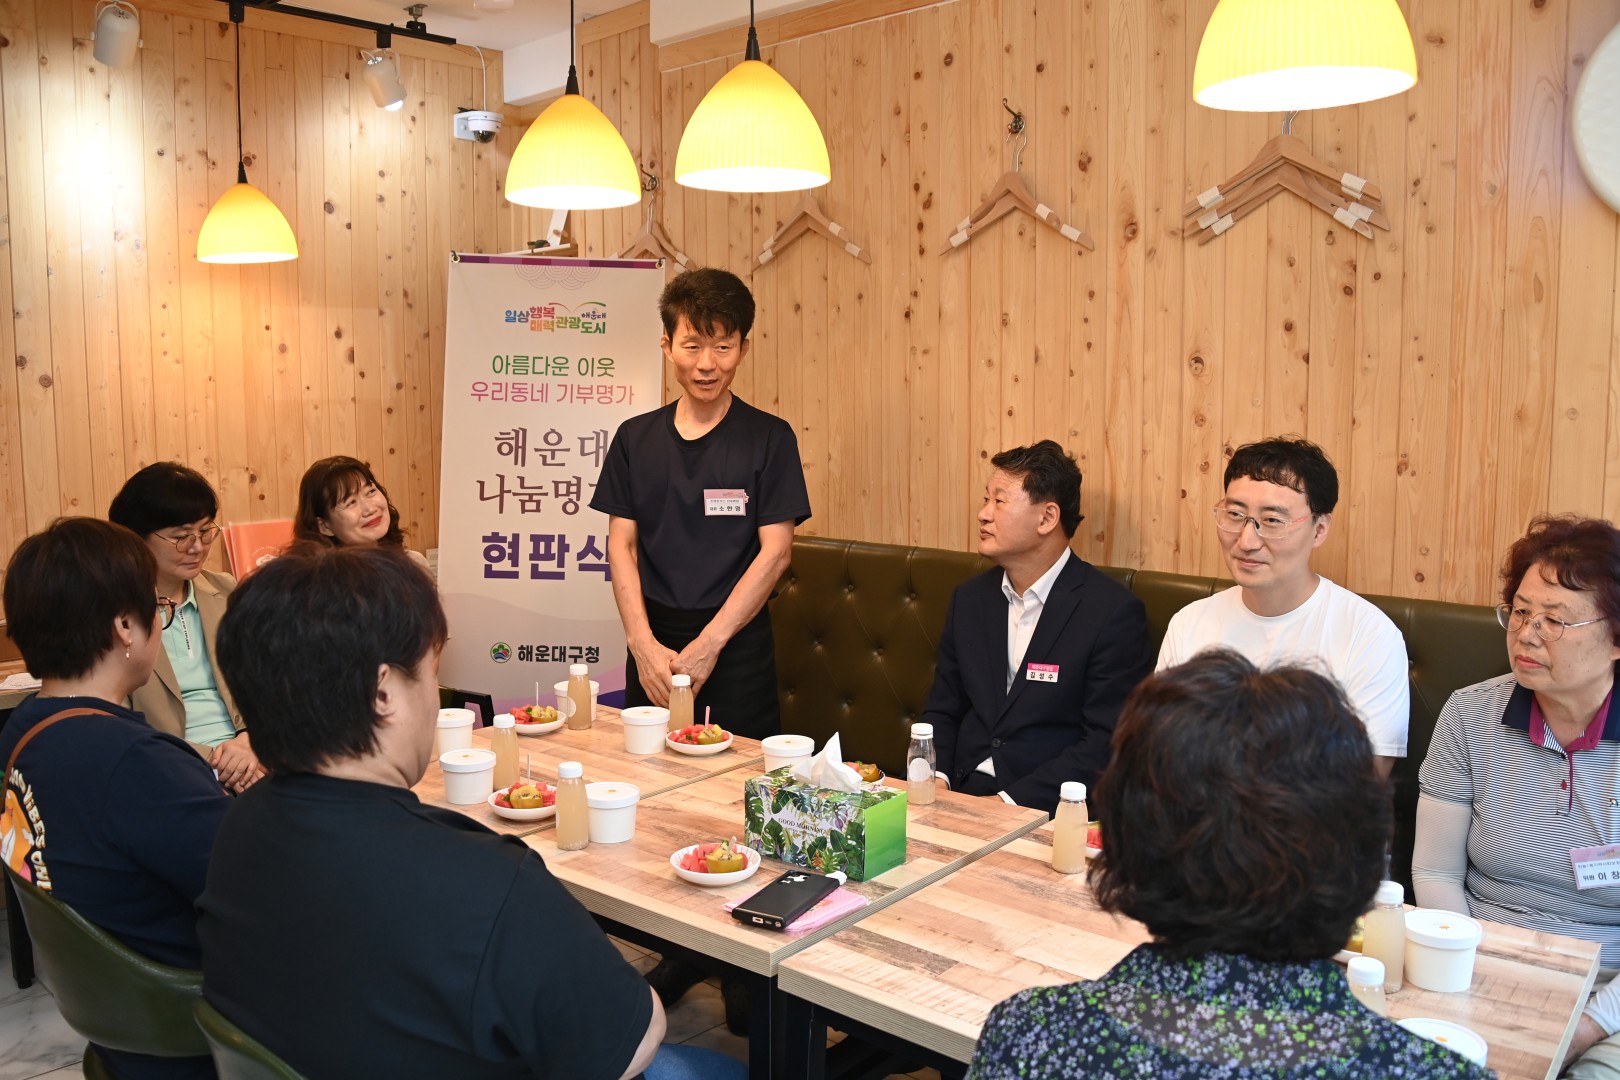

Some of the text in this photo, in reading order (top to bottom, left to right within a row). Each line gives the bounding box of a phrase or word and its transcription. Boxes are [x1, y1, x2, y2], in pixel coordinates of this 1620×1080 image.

[492, 355, 615, 378] 아름다운 이웃
[470, 381, 635, 405] 우리동네 기부명가
[476, 473, 601, 516] 나눔명
[482, 532, 612, 582] 현판식
[517, 644, 600, 664] 해운대구청
